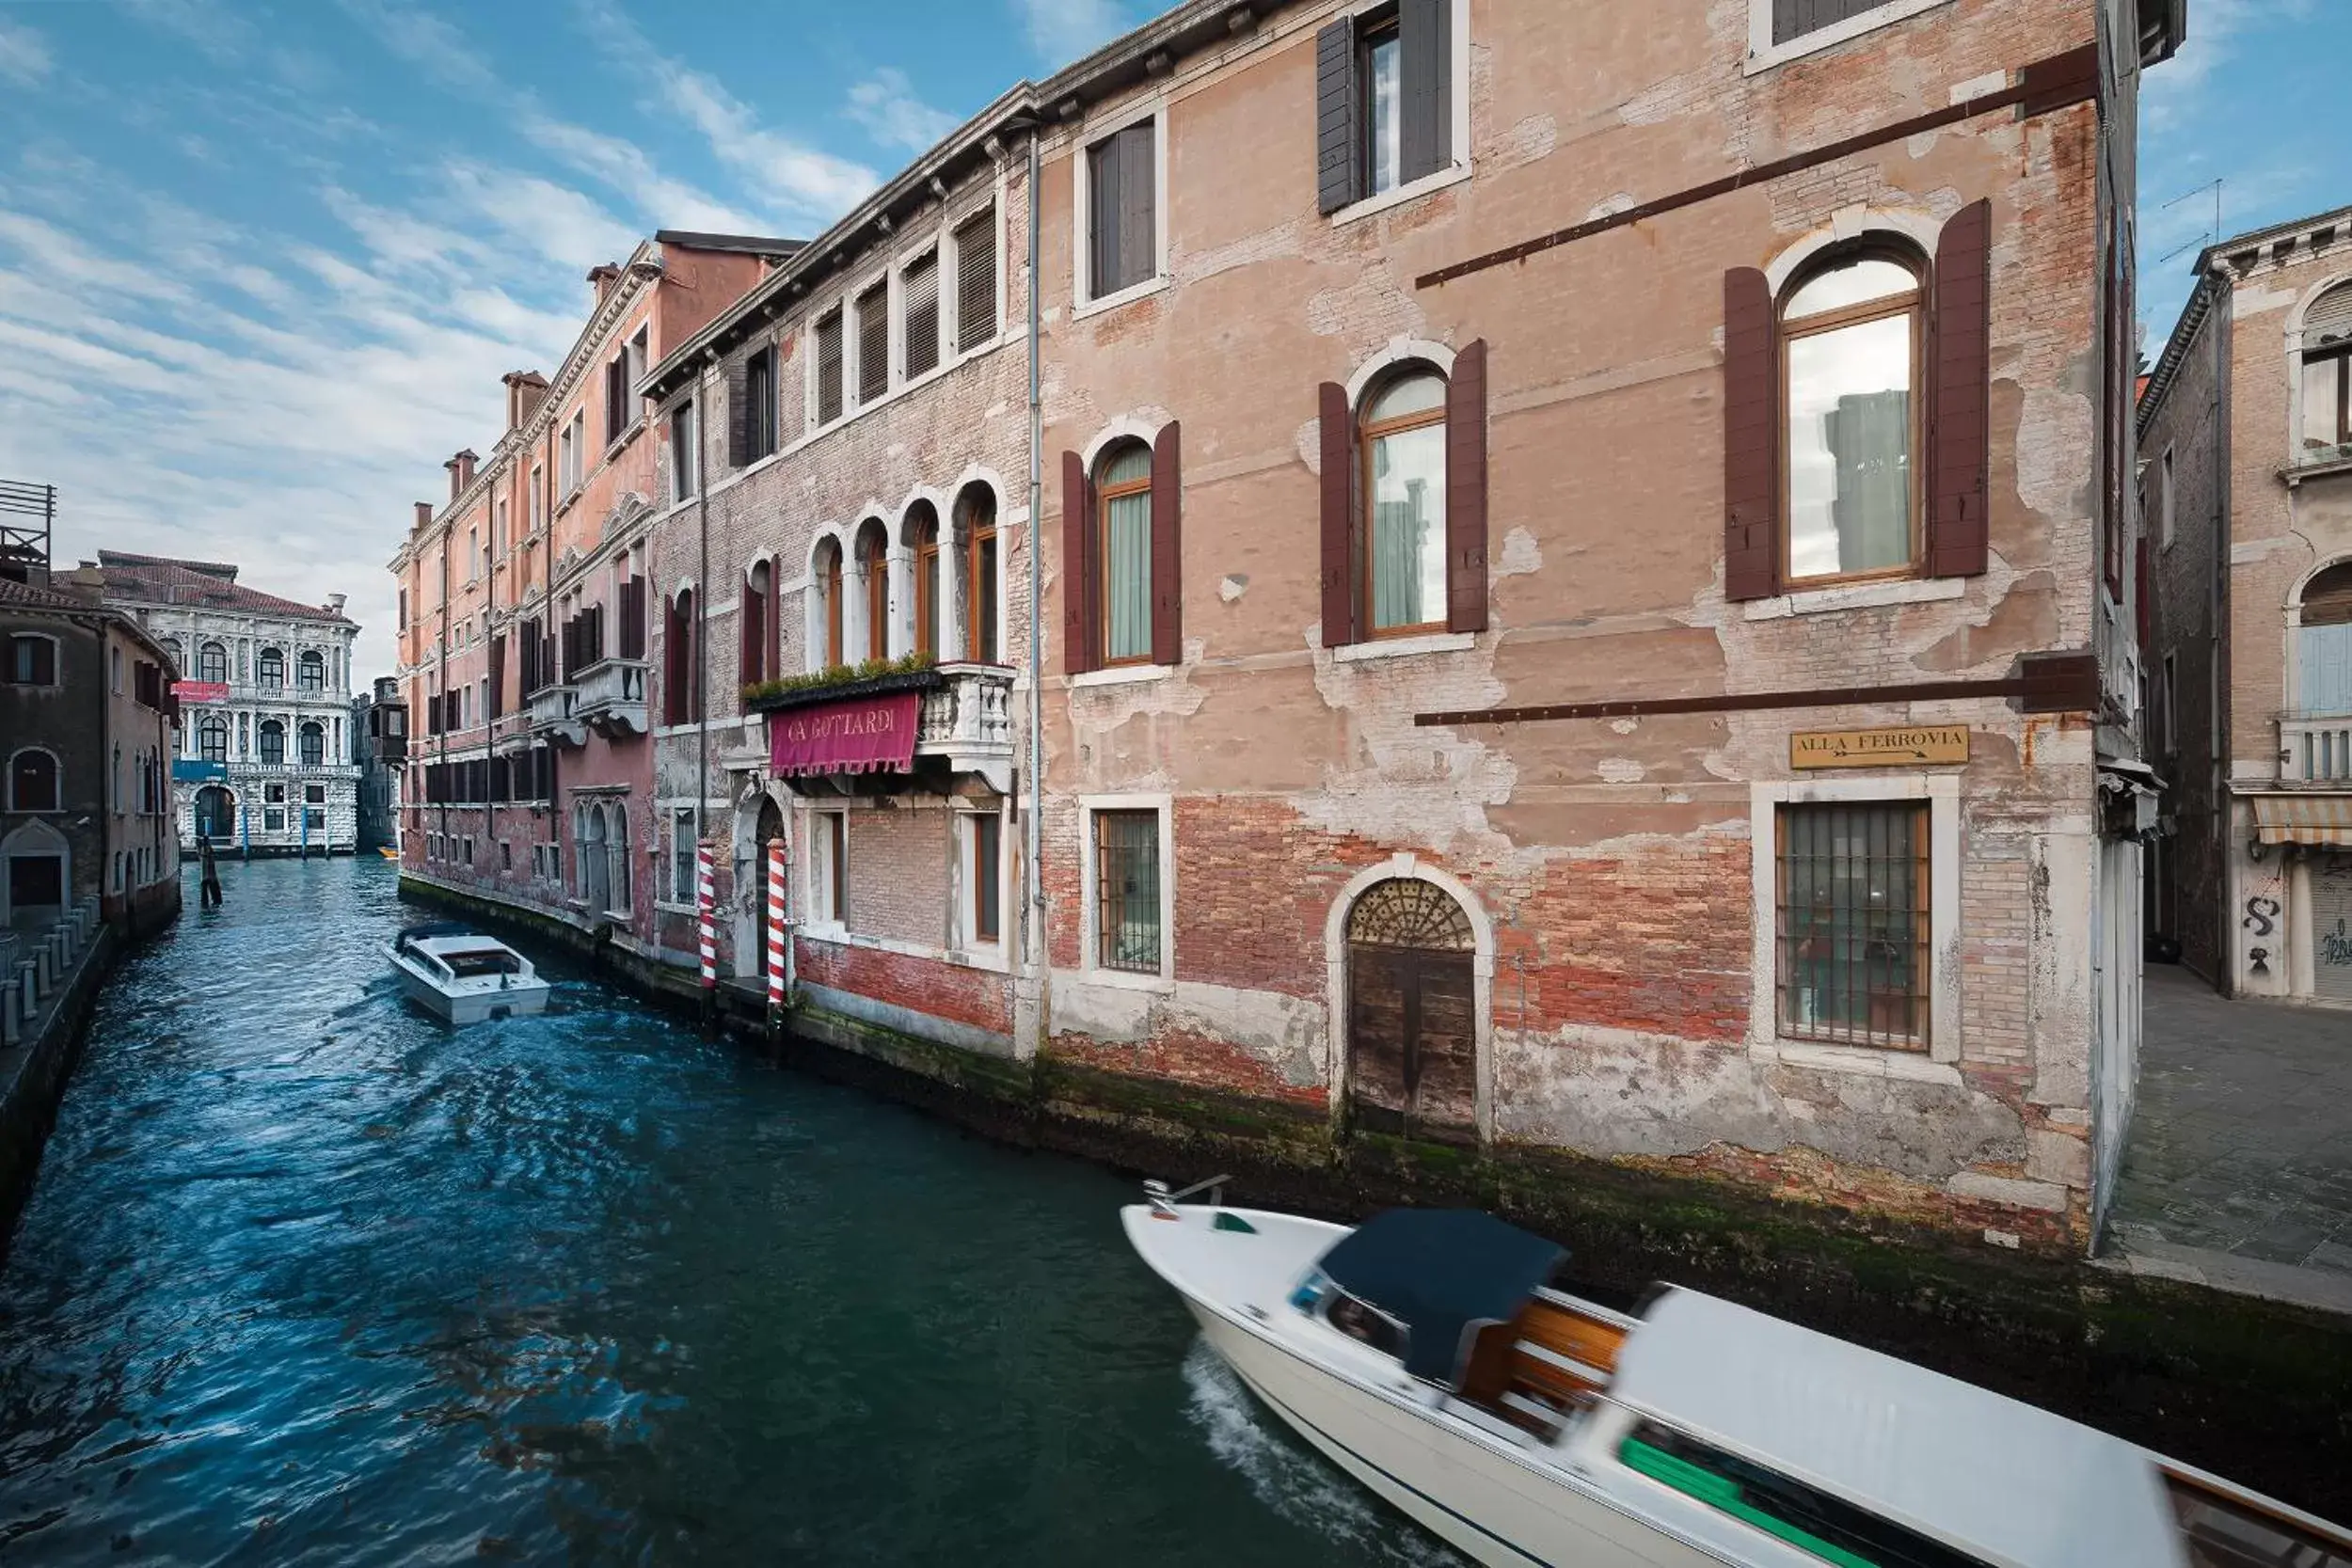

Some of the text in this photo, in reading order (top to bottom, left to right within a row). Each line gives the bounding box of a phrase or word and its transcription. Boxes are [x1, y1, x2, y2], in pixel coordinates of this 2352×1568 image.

[812, 709, 894, 738] GOTTARDI
[1798, 731, 1963, 752] ALLA FERROVIA
